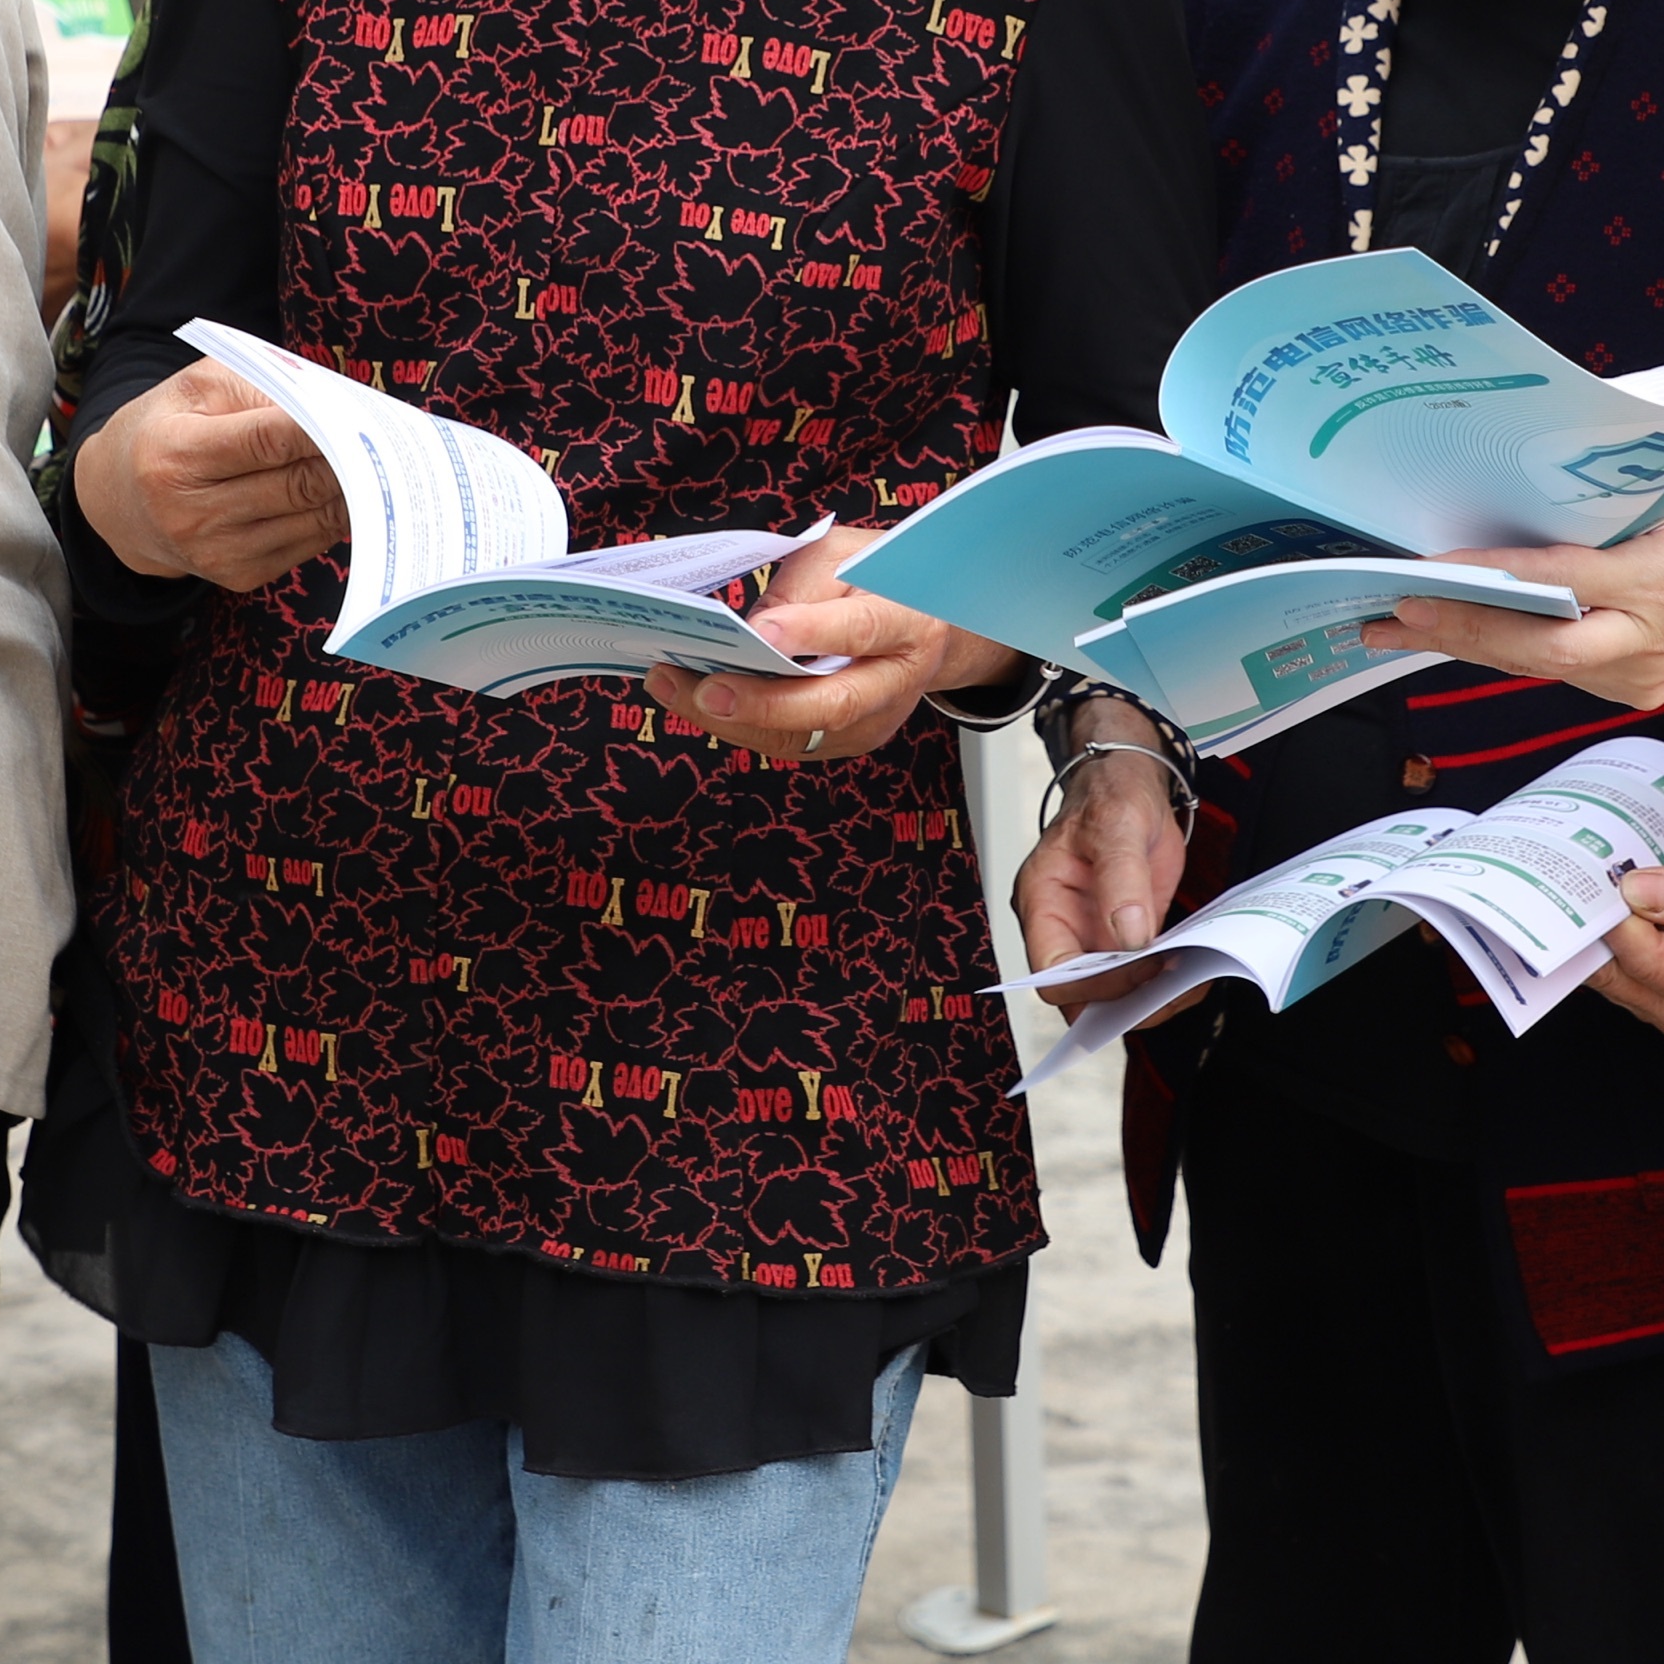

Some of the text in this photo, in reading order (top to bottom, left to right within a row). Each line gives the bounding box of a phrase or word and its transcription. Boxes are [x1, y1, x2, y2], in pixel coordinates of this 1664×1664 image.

[353, 13, 475, 63] Love You
[700, 32, 832, 96] Love You
[337, 183, 383, 230] You
[389, 182, 457, 233] Love
[679, 201, 787, 252] Love You
[1223, 301, 1497, 466] 防范电信网络诈骗
[1308, 343, 1457, 390] 宣传手册
[643, 367, 756, 425] ove You
[783, 407, 837, 447] You
[254, 675, 298, 722] You
[301, 679, 356, 727] Love
[610, 702, 657, 744] You
[244, 853, 325, 898] Love You
[566, 869, 712, 940] Love You
[776, 901, 830, 949] You
[229, 1017, 338, 1082] Love You
[549, 1053, 682, 1120] Love You
[736, 1070, 858, 1124] ove You
[906, 1150, 1000, 1197] Love You
